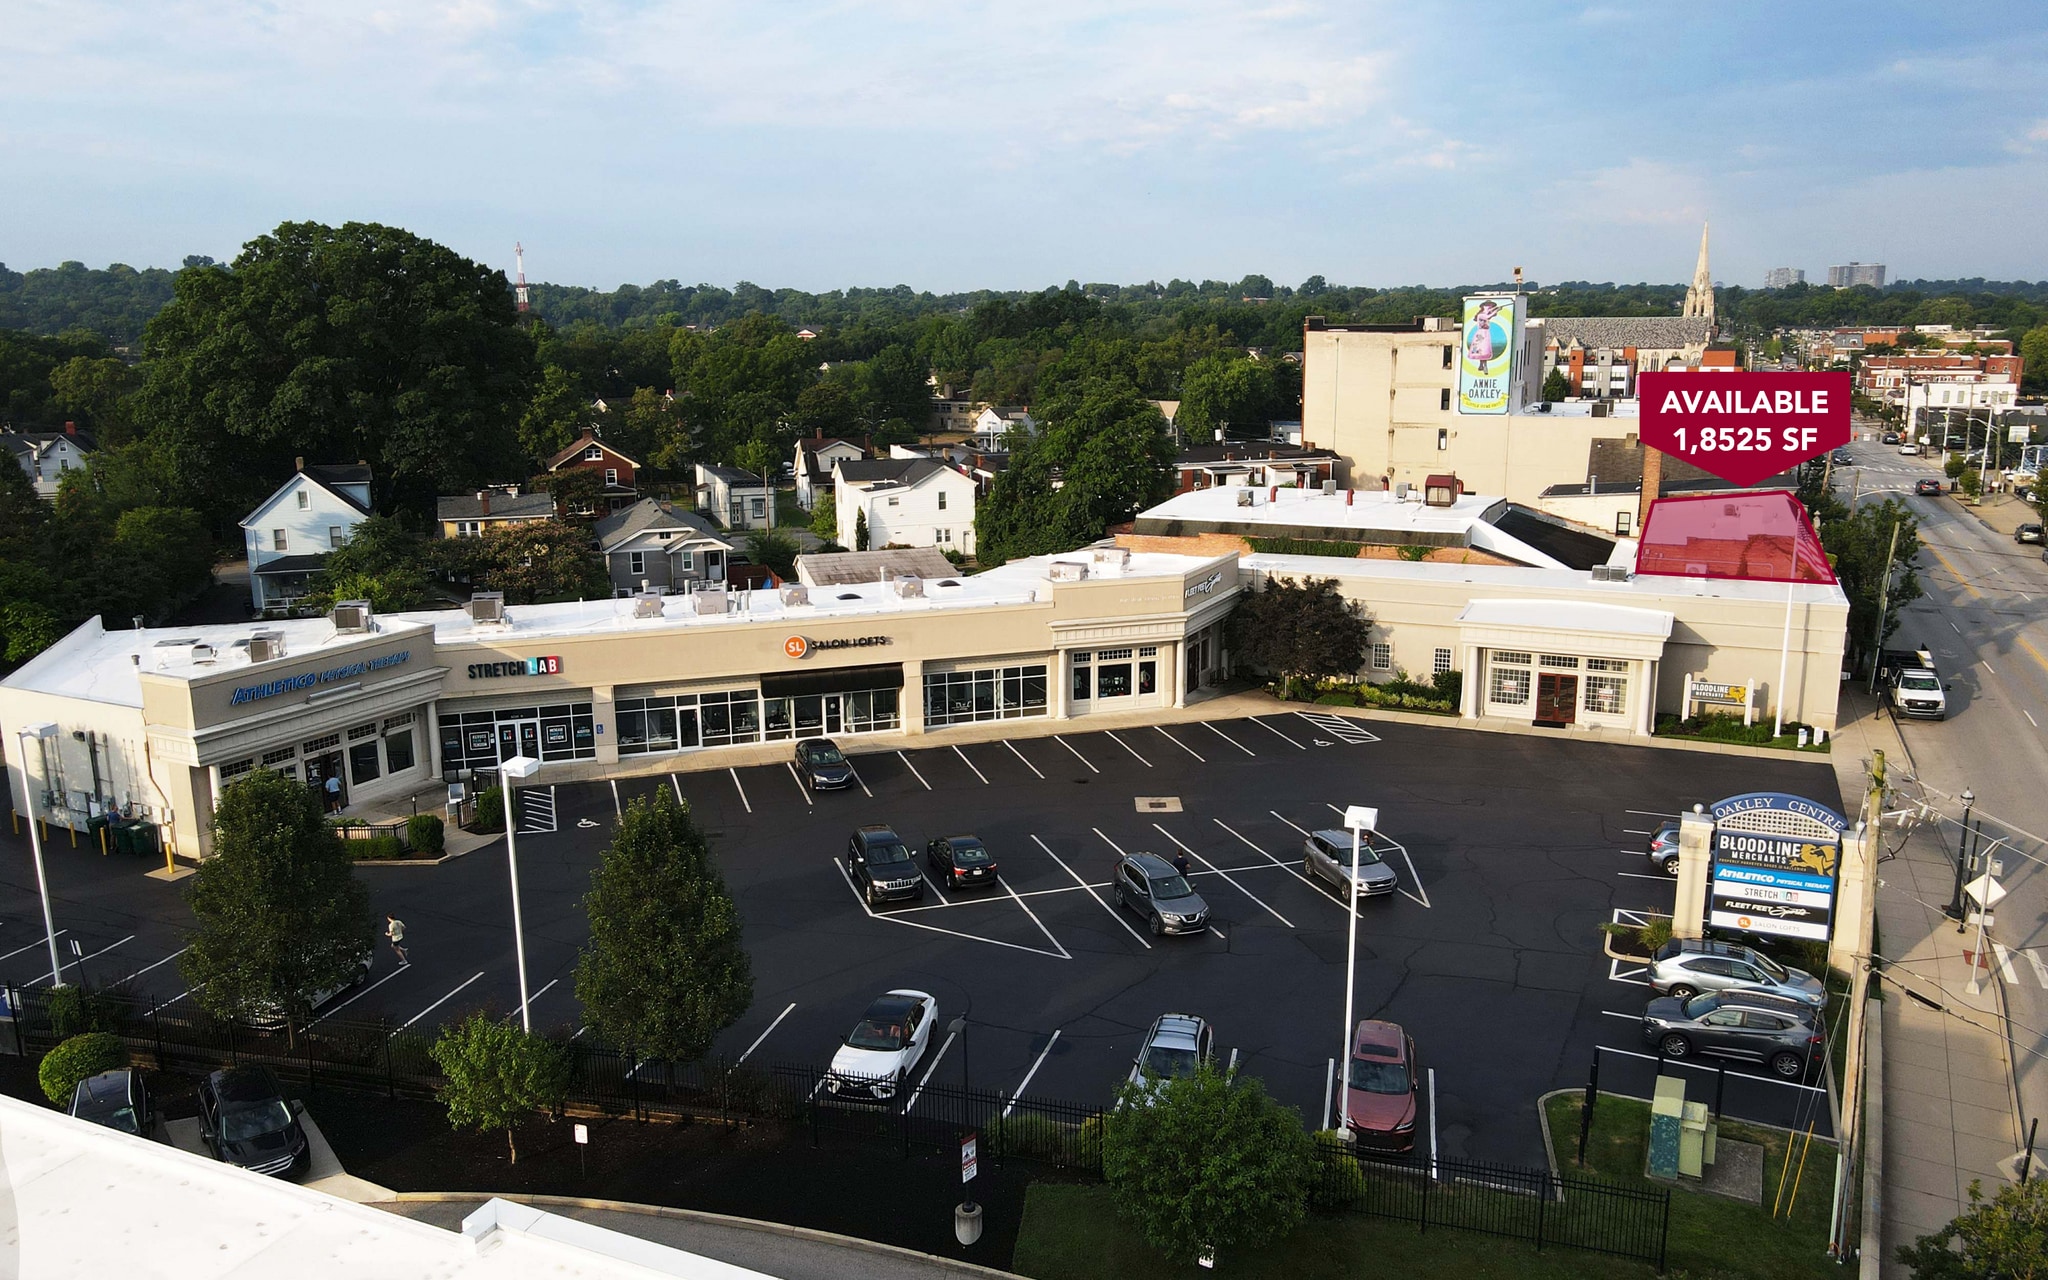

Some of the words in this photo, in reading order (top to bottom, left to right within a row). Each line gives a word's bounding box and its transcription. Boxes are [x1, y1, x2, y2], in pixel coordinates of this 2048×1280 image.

[1473, 379, 1497, 389] ANNIE
[1468, 389, 1501, 399] OAKLEY
[788, 641, 802, 653] SL
[811, 638, 849, 650] SALON
[853, 635, 886, 647] LOFTS
[230, 672, 316, 705] ATHLETICO
[1692, 683, 1729, 694] BLOODLINE
[1715, 798, 1775, 819] OAKLEY
[1788, 800, 1844, 831] CENTRE
[1719, 835, 1801, 858] BLOODLINE
[1731, 851, 1787, 865] MERCHANTS
[1718, 868, 1775, 883] ATHLETICO
[1775, 878, 1803, 887] PHYSICAL
[1804, 882, 1831, 890] THERAPY
[1725, 901, 1752, 910] FLEET
[1751, 903, 1773, 912] FEET
[1754, 921, 1777, 929] SALON
[1779, 923, 1801, 933] LOFTS
